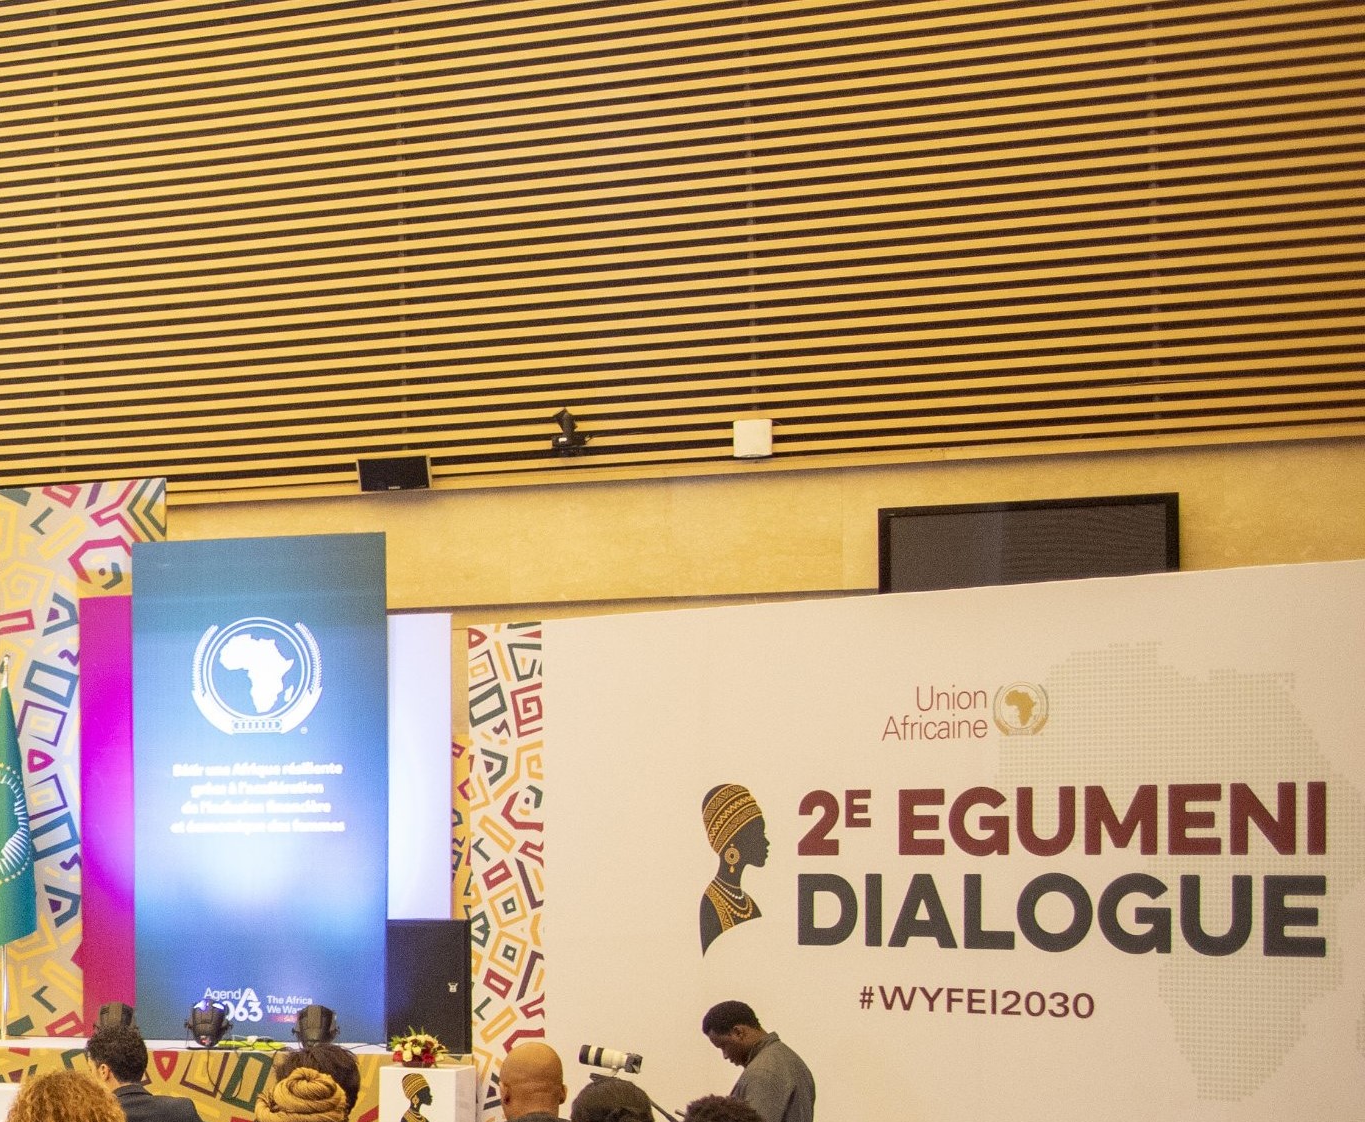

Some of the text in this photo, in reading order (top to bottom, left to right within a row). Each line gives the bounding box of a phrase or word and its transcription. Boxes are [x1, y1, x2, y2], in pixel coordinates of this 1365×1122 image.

[916, 686, 988, 713] Union
[882, 713, 988, 741] Africaine
[797, 781, 1327, 856] 2E EGUMENI
[797, 872, 1327, 958] DIALOGUE
[267, 995, 313, 1005] The Africa
[267, 1005, 281, 1014] We
[859, 985, 1095, 1019] #WYFEI2030
